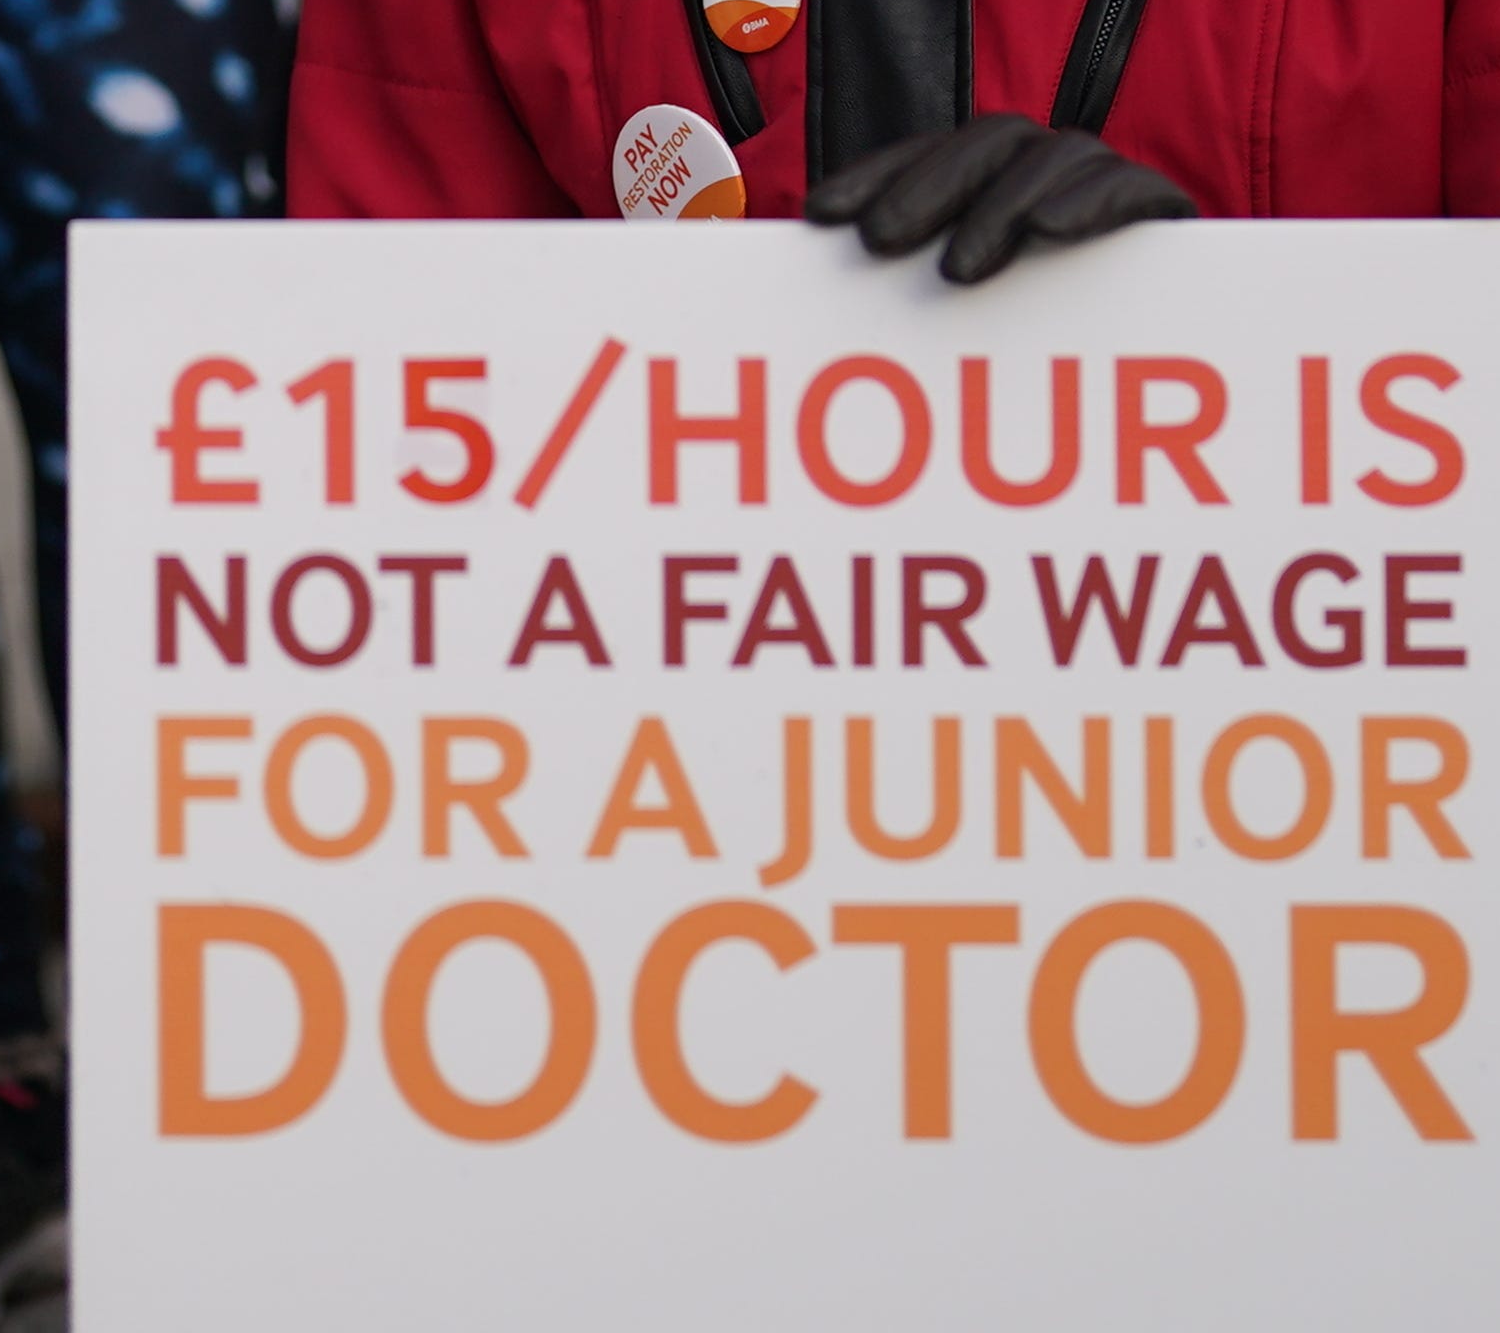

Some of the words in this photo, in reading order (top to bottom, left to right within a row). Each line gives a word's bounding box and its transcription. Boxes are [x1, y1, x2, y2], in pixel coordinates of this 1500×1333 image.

[749, 16, 771, 32] BMA
[622, 121, 694, 213] RESTORATION
[623, 122, 659, 174] PAY
[647, 155, 692, 216] NOW
[154, 336, 1233, 512] £15/HOUR
[1300, 351, 1468, 509] IS
[156, 553, 469, 671] NOT
[507, 553, 615, 670] A
[659, 553, 991, 671] FAIR
[1030, 551, 1469, 671] WAGE
[156, 711, 533, 864] FOR
[585, 714, 720, 862] A
[757, 711, 1473, 890] JUNIOR
[156, 898, 1479, 1149] DOCTOR
